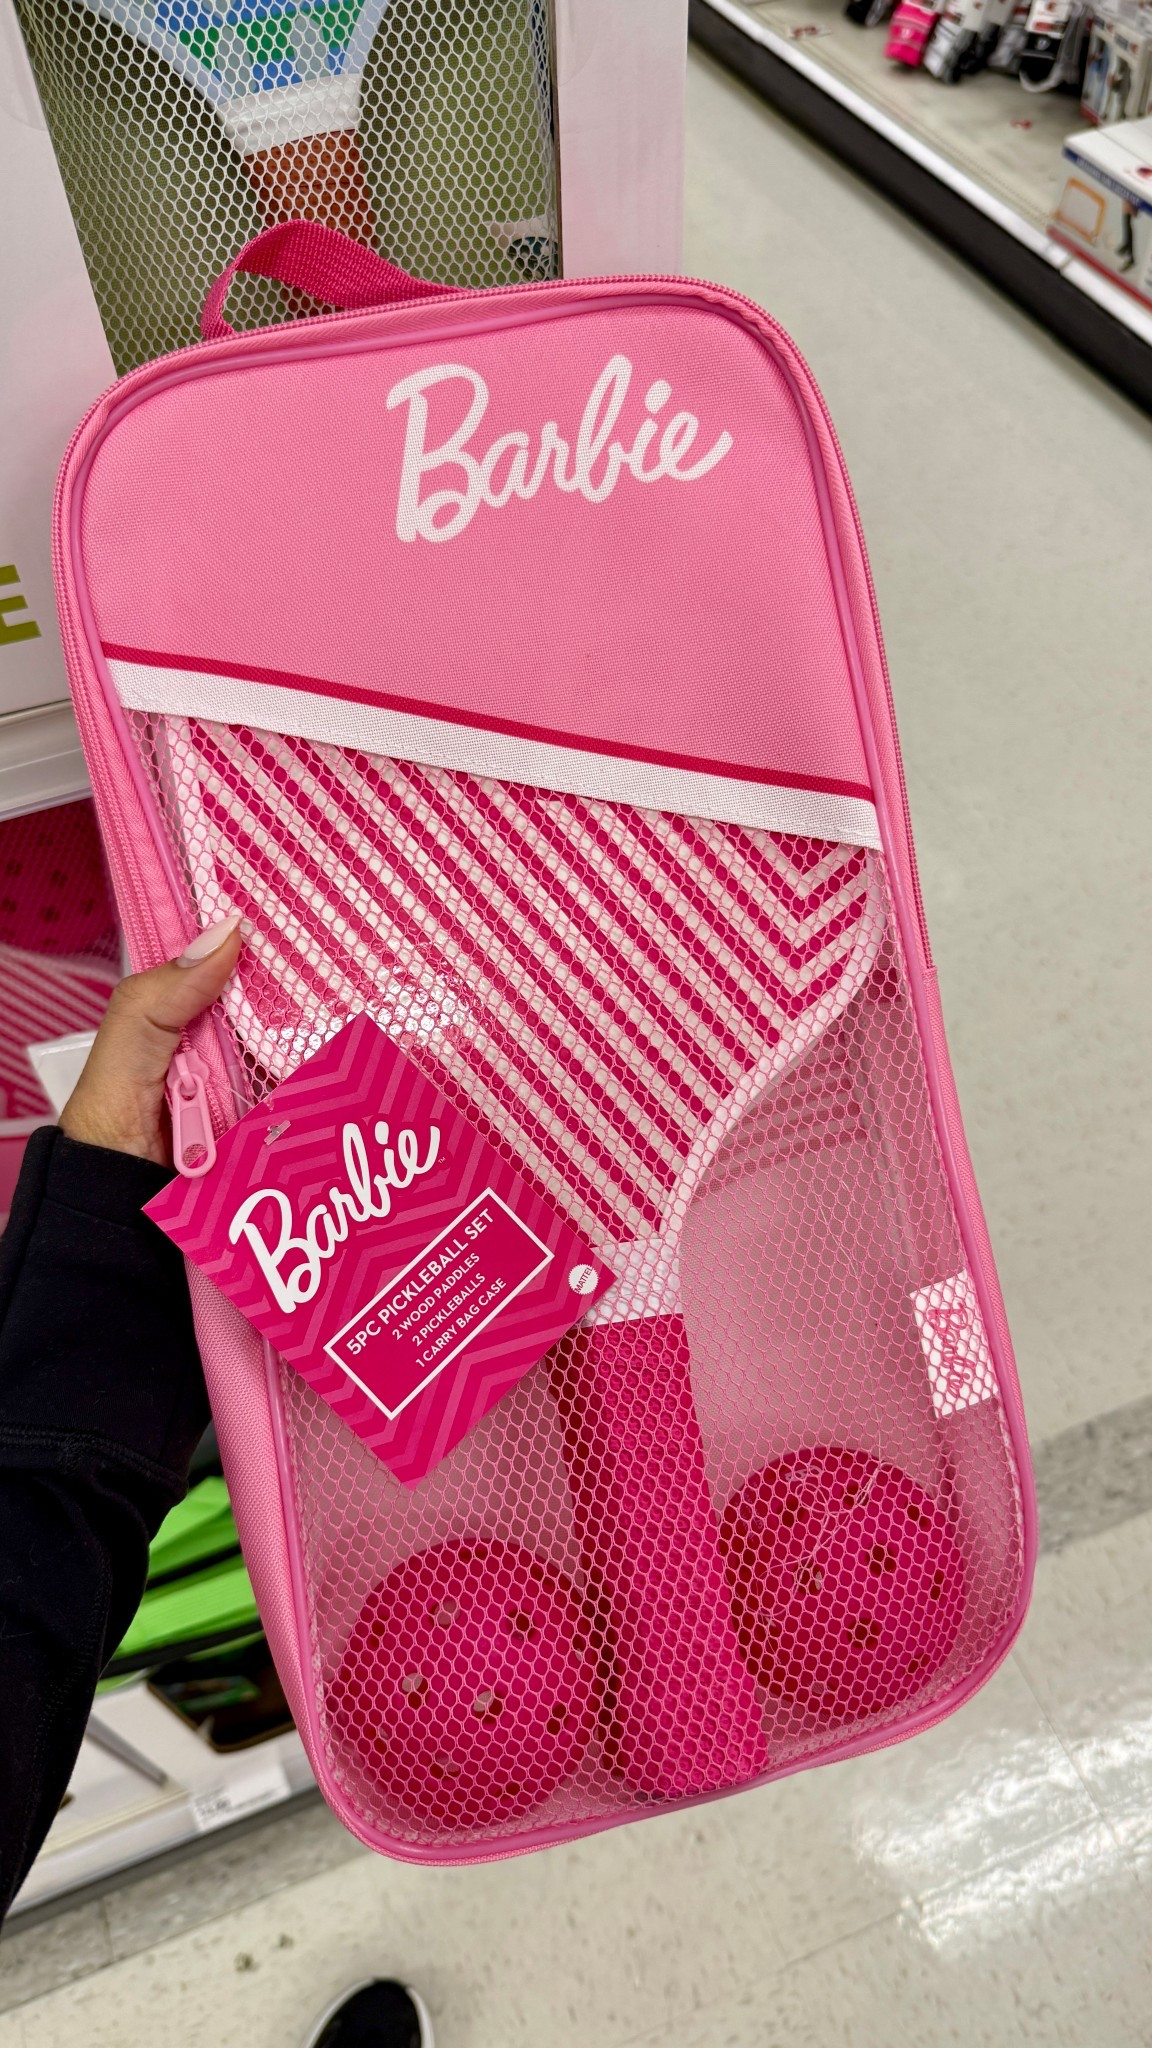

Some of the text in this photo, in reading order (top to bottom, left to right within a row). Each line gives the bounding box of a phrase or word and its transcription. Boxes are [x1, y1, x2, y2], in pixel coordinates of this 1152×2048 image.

[386, 354, 734, 543] Barbie
[228, 1120, 441, 1313] Barbie
[346, 1208, 494, 1355] 5PC PICKLEBALL SET
[392, 1252, 480, 1340] 2 WOOD PADDLES
[412, 1273, 486, 1347] 2 PICKLEBALLS
[415, 1277, 507, 1368] 1 CARRY BAG CASE
[574, 1266, 593, 1292] MATTEL
